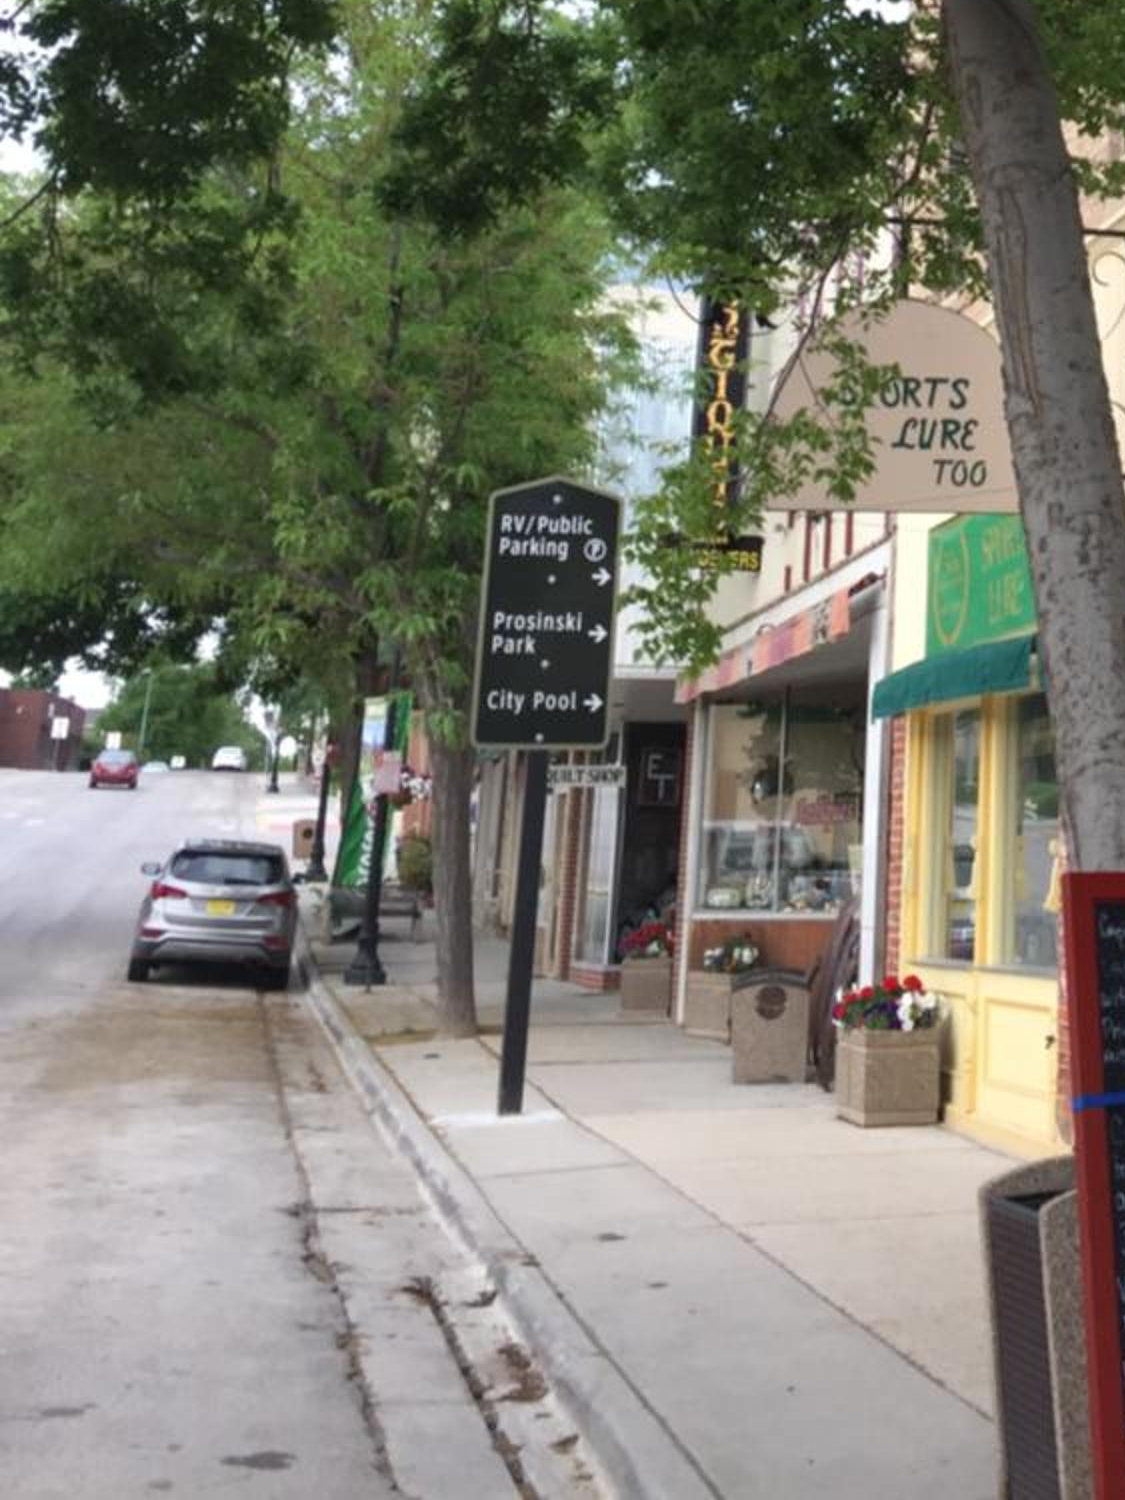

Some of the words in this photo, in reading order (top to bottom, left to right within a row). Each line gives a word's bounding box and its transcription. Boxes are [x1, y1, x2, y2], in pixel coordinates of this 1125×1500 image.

[840, 376, 970, 410] SORTS
[890, 416, 980, 451] LURE
[932, 458, 988, 487] TOO
[500, 514, 593, 536] RV/Public
[498, 536, 569, 562] Parking
[493, 611, 583, 633] Prosinski
[490, 634, 537, 655] Park
[486, 690, 525, 714] City
[533, 691, 578, 711] Pool
